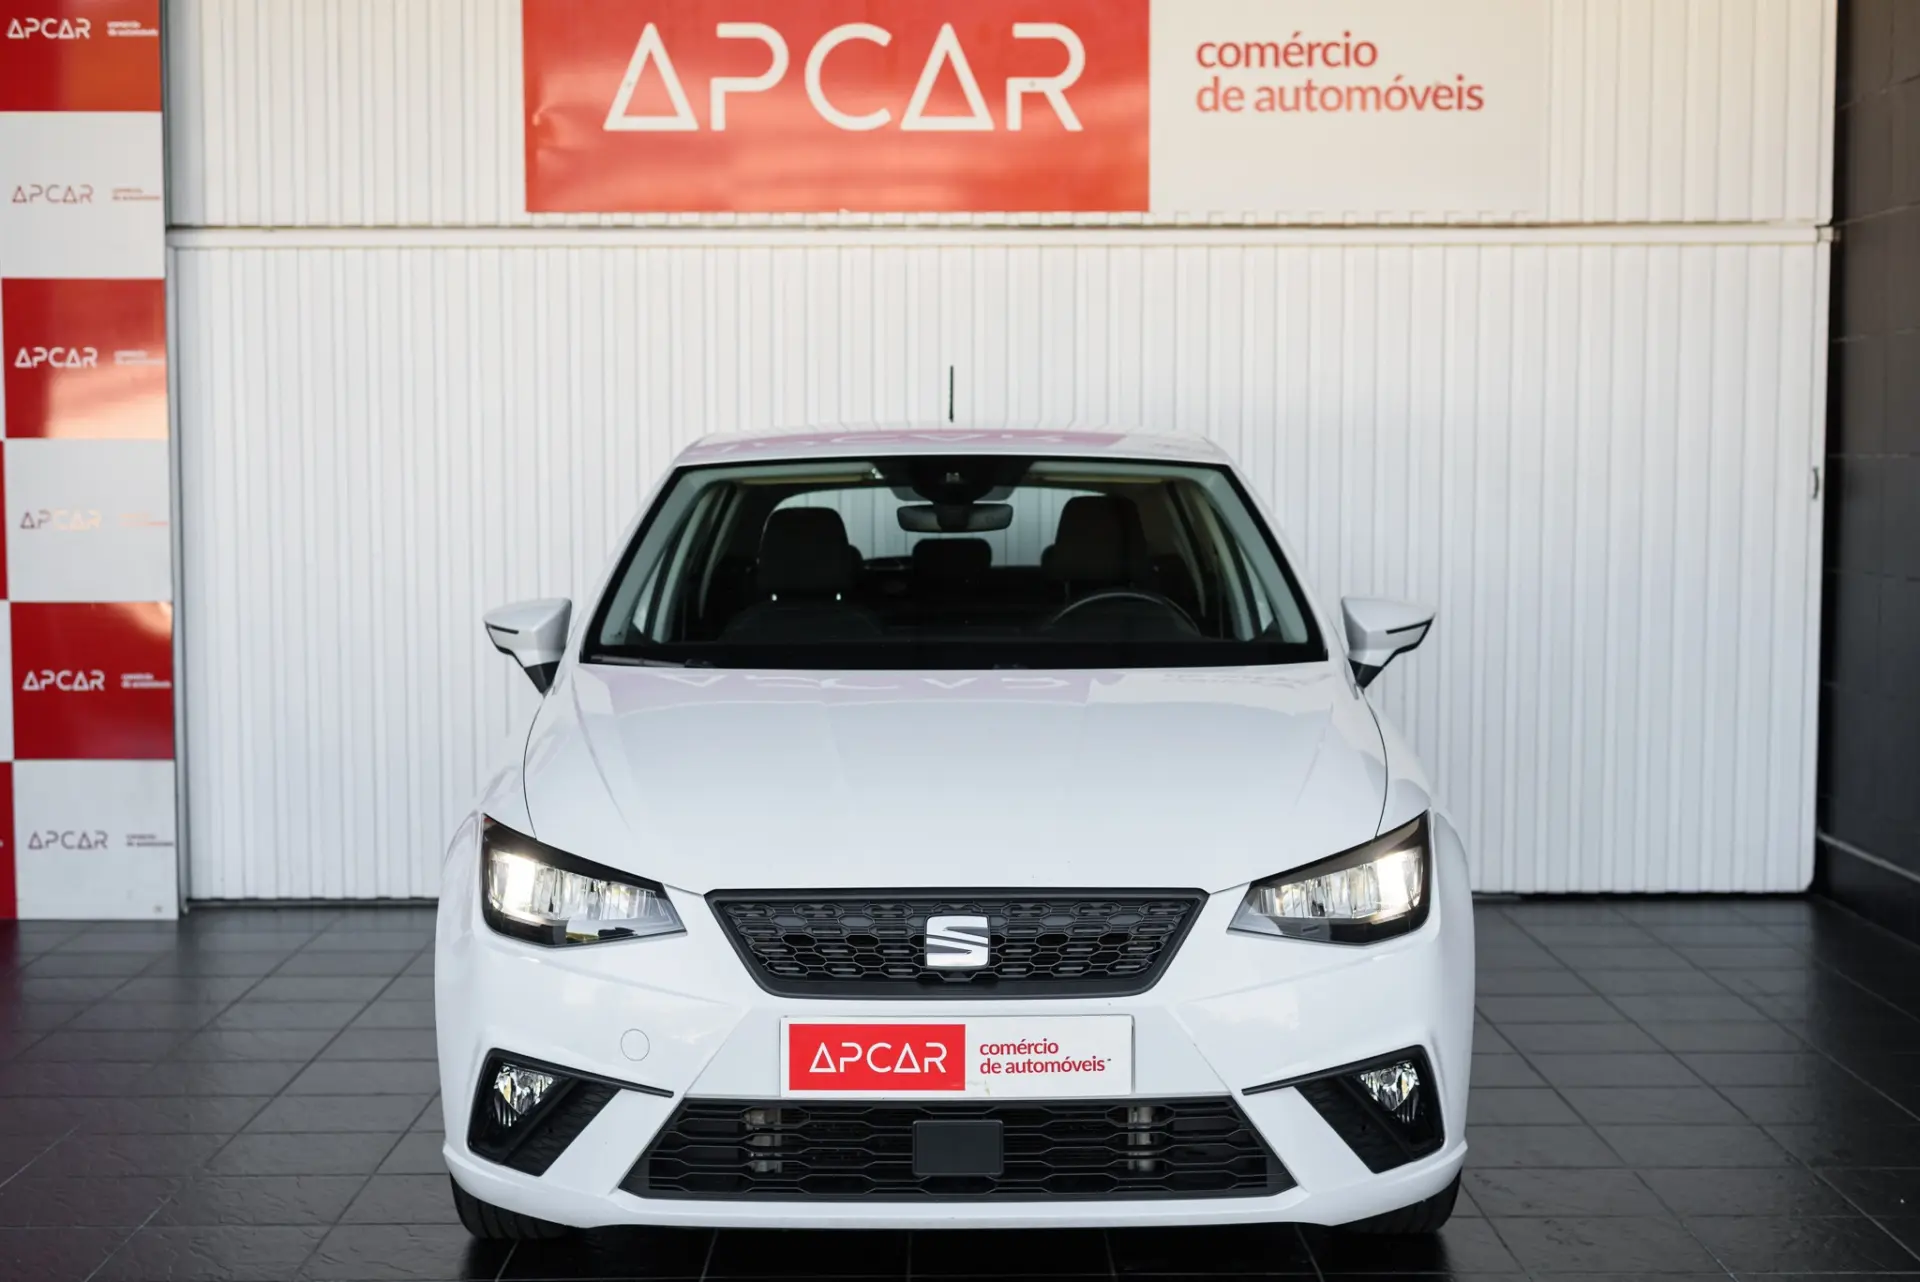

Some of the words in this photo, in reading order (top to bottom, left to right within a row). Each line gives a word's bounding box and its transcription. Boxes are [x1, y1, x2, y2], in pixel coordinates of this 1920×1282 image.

[7, 18, 91, 39] APCAR
[1196, 30, 1378, 68] comércio
[603, 22, 1085, 131] APCAR
[1196, 75, 1245, 112] de
[1254, 74, 1485, 112] automóveis
[12, 184, 94, 203] APCAR
[14, 347, 98, 368] APCAR
[22, 670, 105, 691] APCAR
[28, 830, 109, 850] APCAR
[980, 1038, 1059, 1055] comércio
[809, 1042, 947, 1073] APCAR
[980, 1058, 1001, 1074] de
[1005, 1055, 1105, 1073] automóveis
